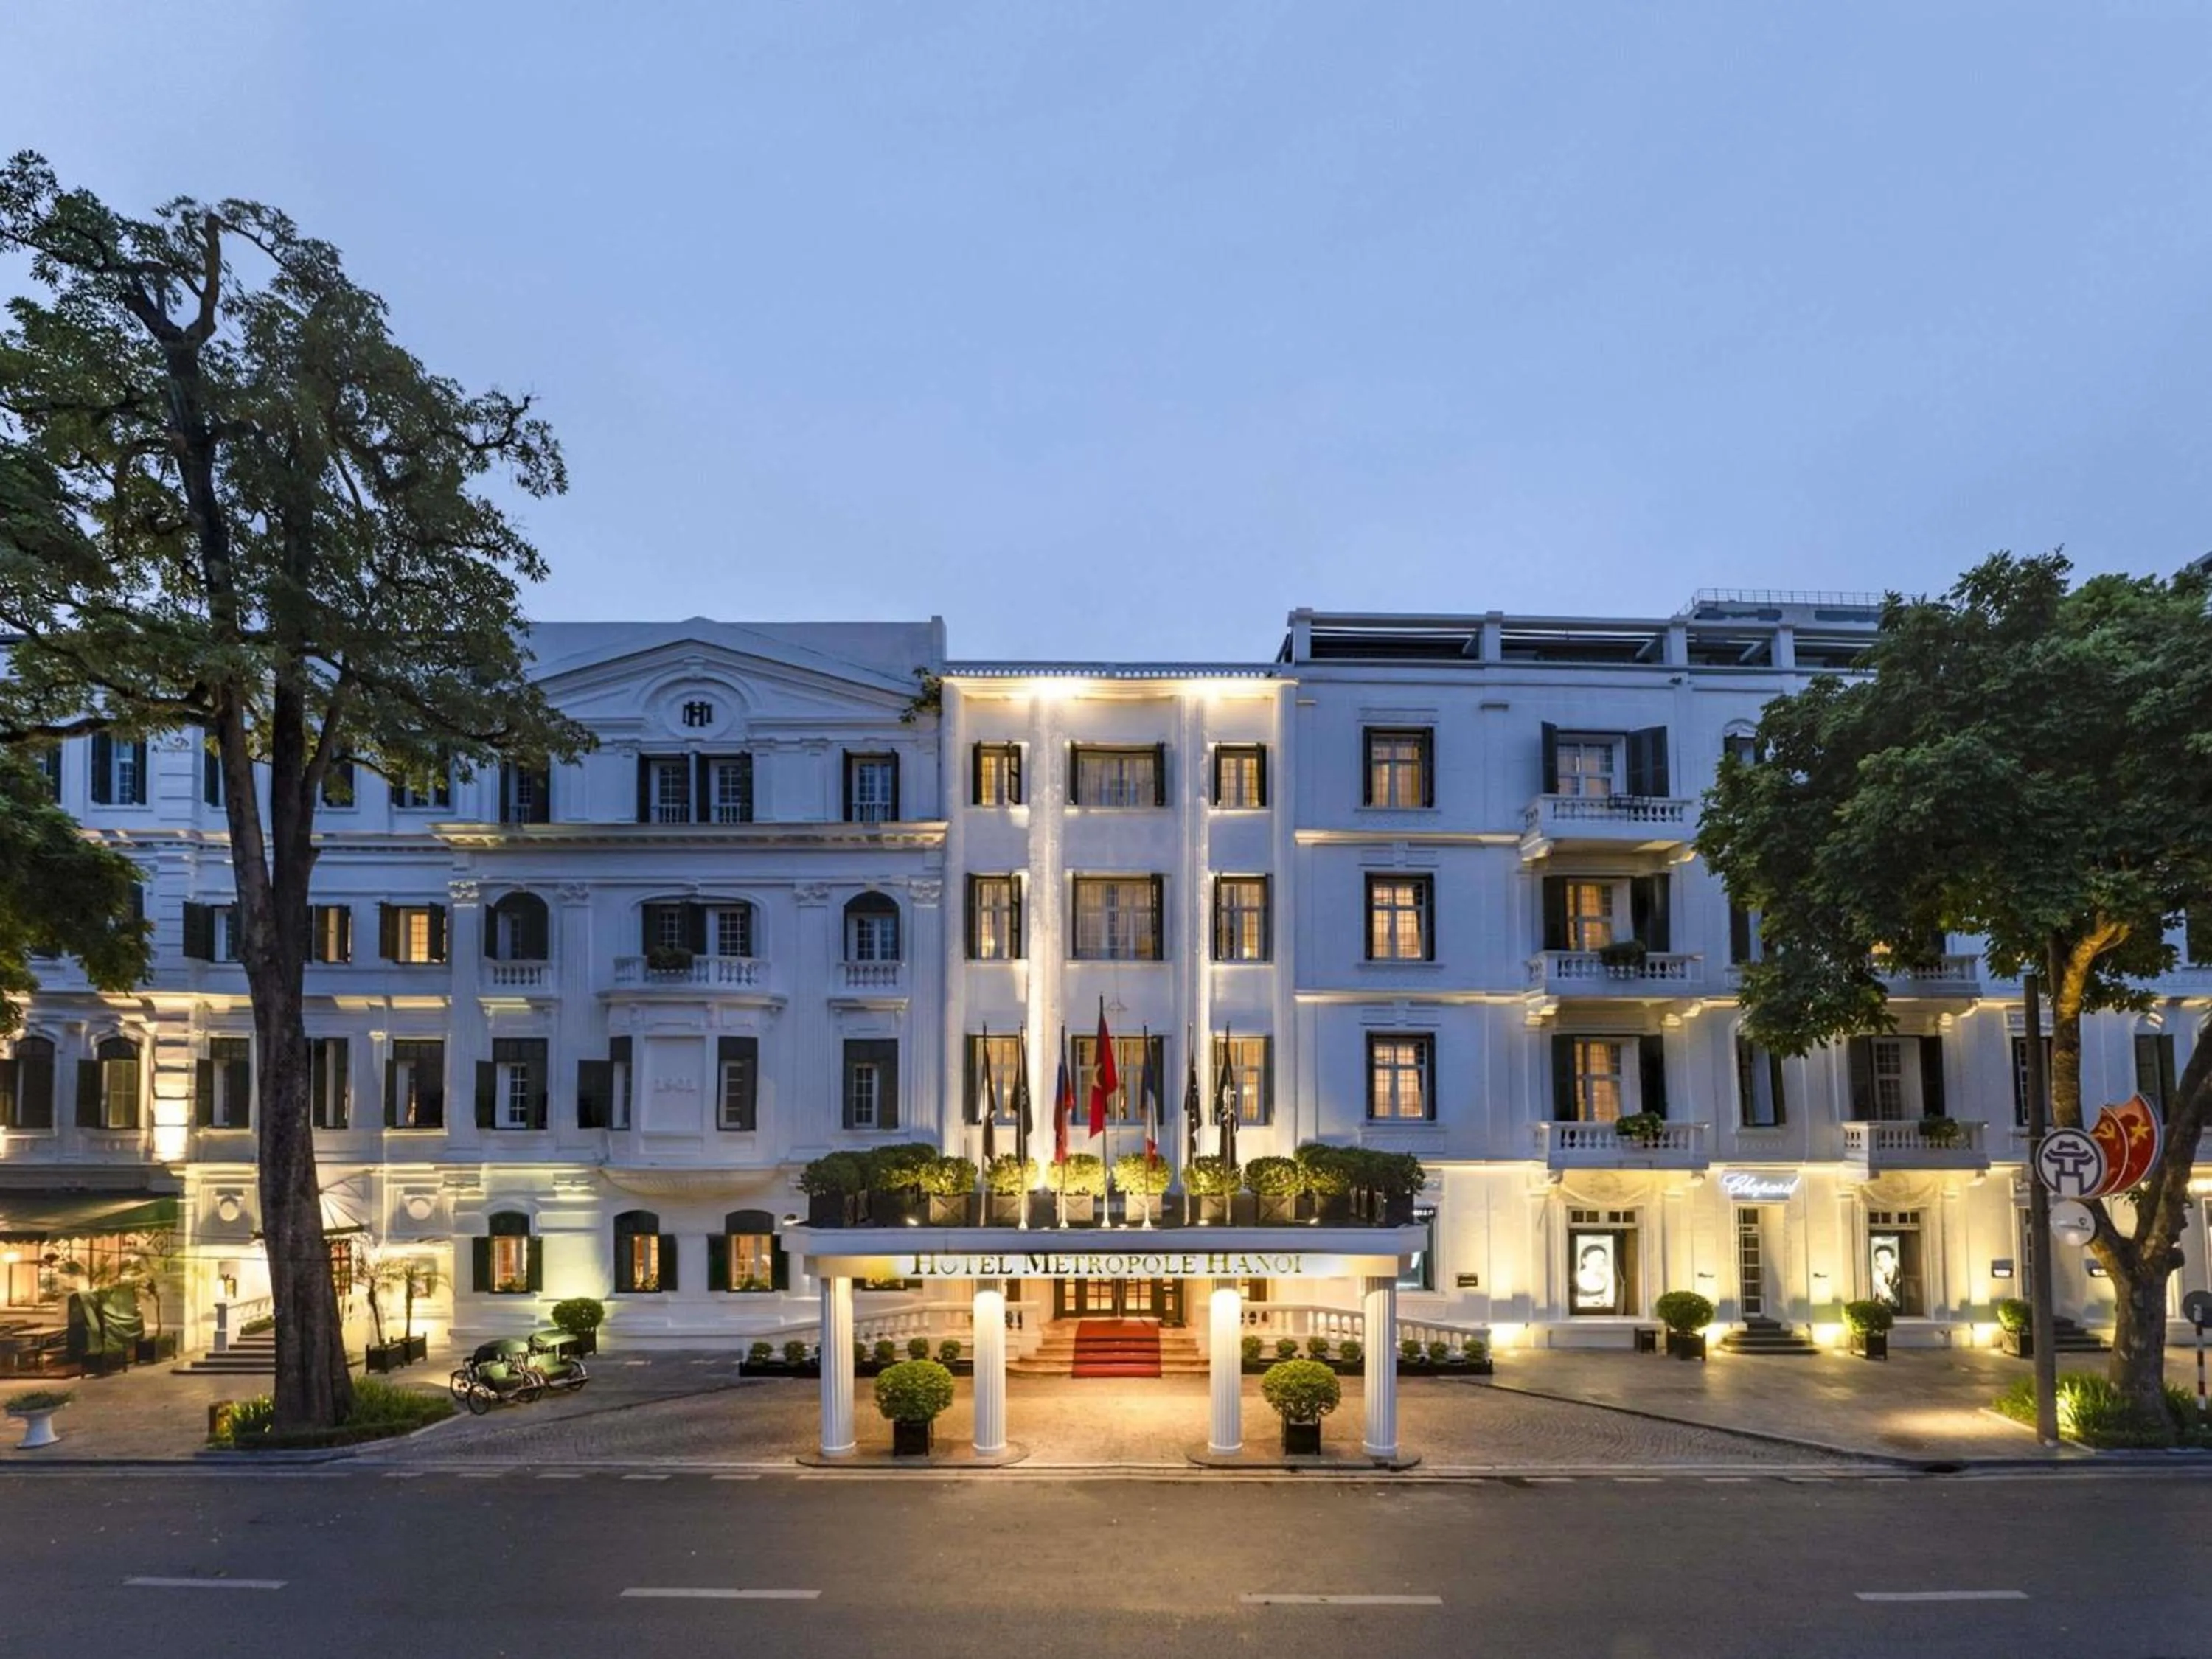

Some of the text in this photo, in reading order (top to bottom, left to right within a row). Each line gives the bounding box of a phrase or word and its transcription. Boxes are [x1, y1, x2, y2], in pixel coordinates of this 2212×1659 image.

[911, 1251, 1302, 1275] HOTEL METROPOLE HANOI
